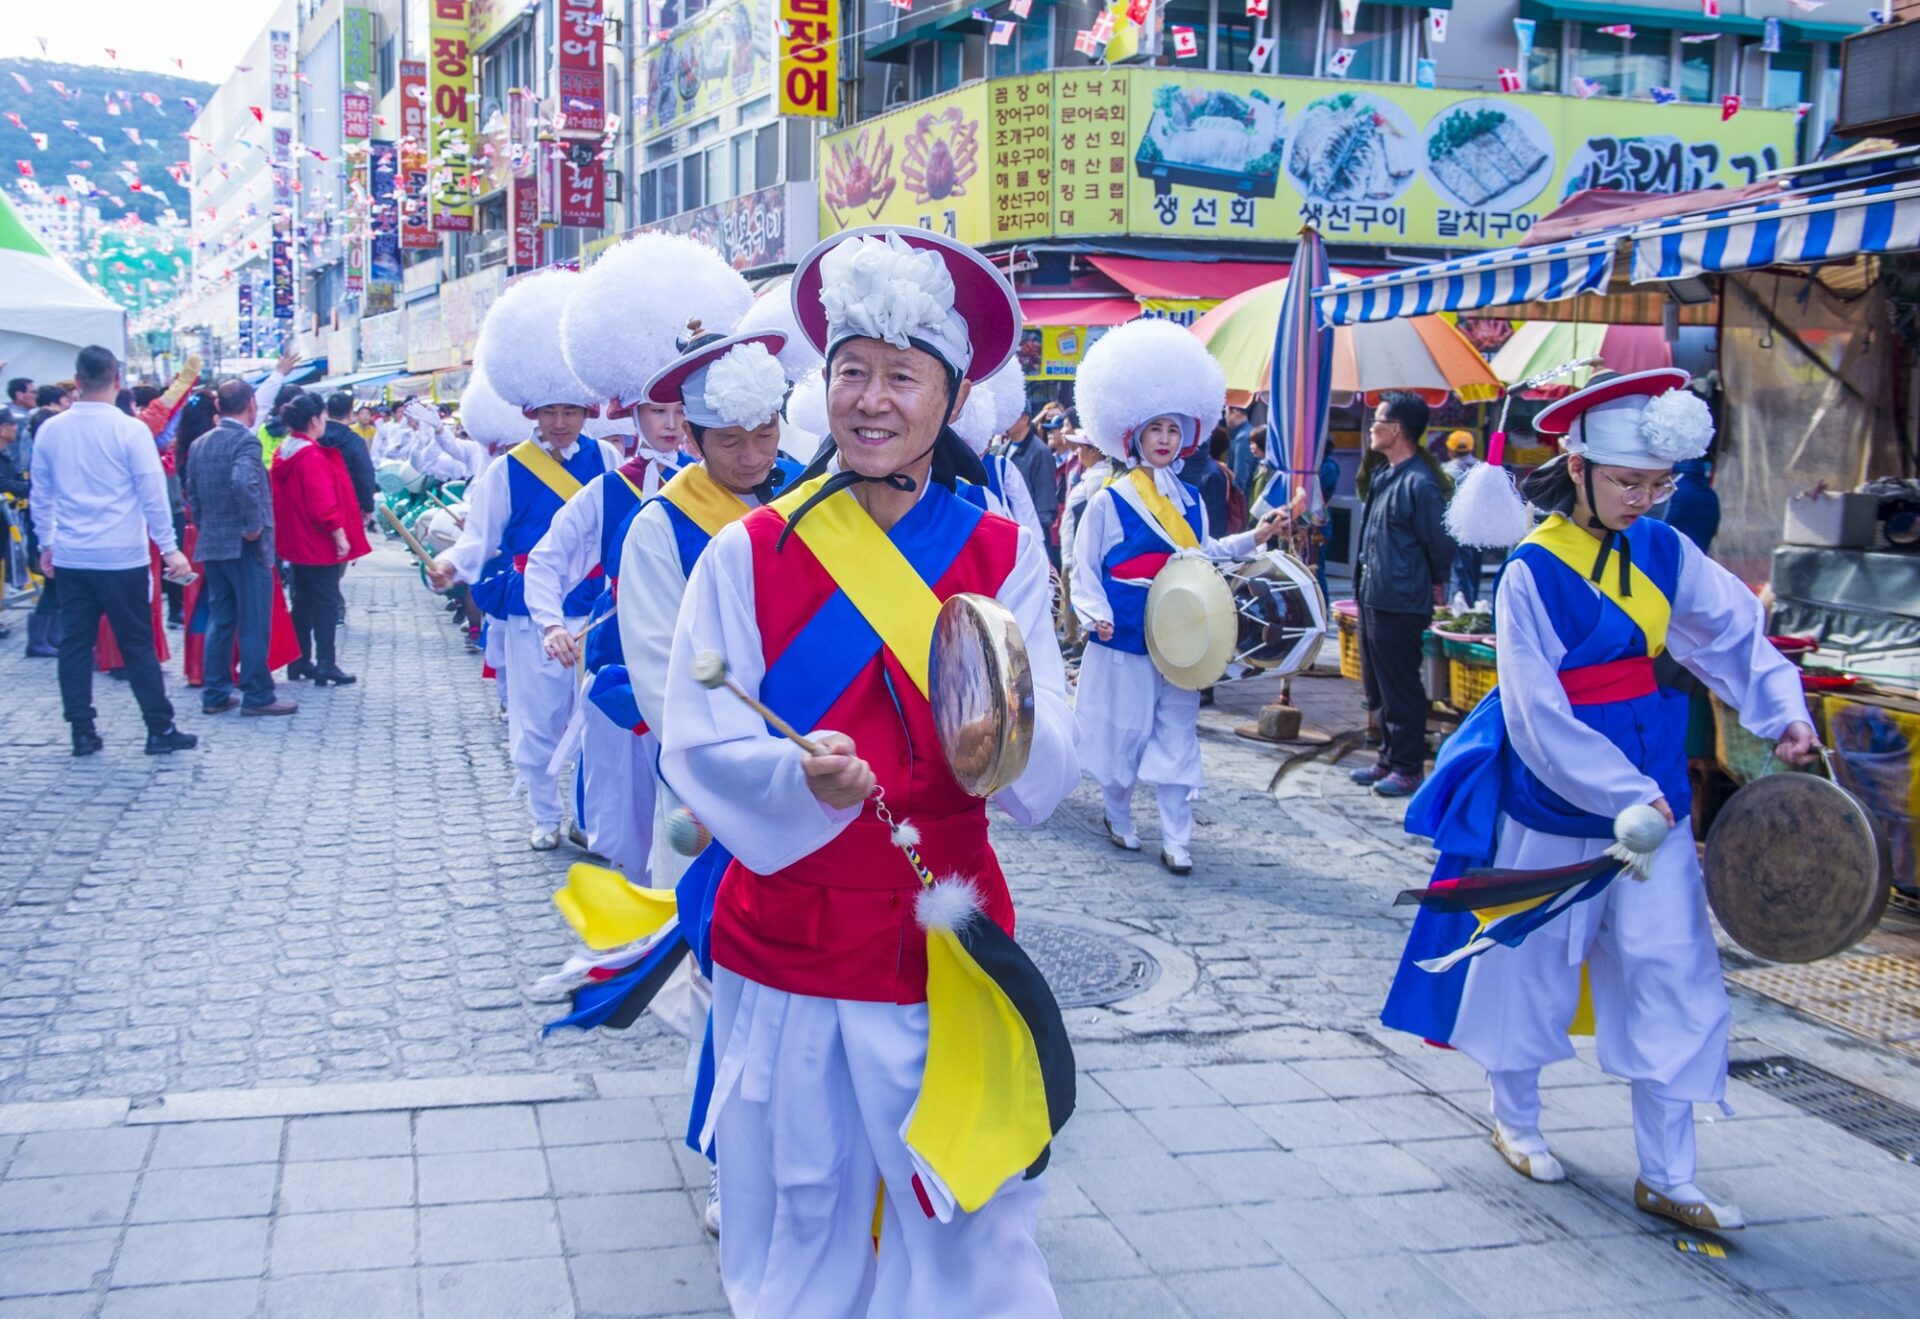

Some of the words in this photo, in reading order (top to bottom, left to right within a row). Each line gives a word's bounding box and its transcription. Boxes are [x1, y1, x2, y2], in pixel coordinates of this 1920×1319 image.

[562, 0, 597, 66] 장어
[1062, 79, 1126, 98] 산낙지
[995, 103, 1049, 126] 장어구이
[1061, 105, 1125, 124] 문어숙회
[996, 125, 1049, 146] 조개구이
[1061, 131, 1125, 150] 생선회
[996, 147, 1049, 168] 새우구이
[1060, 156, 1125, 175] 해산물
[996, 168, 1050, 189] 해물탕
[997, 190, 1049, 211] 생선구이
[1060, 182, 1124, 201] 킹크랩
[998, 211, 1049, 232] 갈치구이
[1060, 208, 1124, 226] 대게
[1153, 195, 1255, 227] 생선회
[1299, 202, 1406, 234] 생선구이
[1437, 208, 1540, 239] 갈치구이
